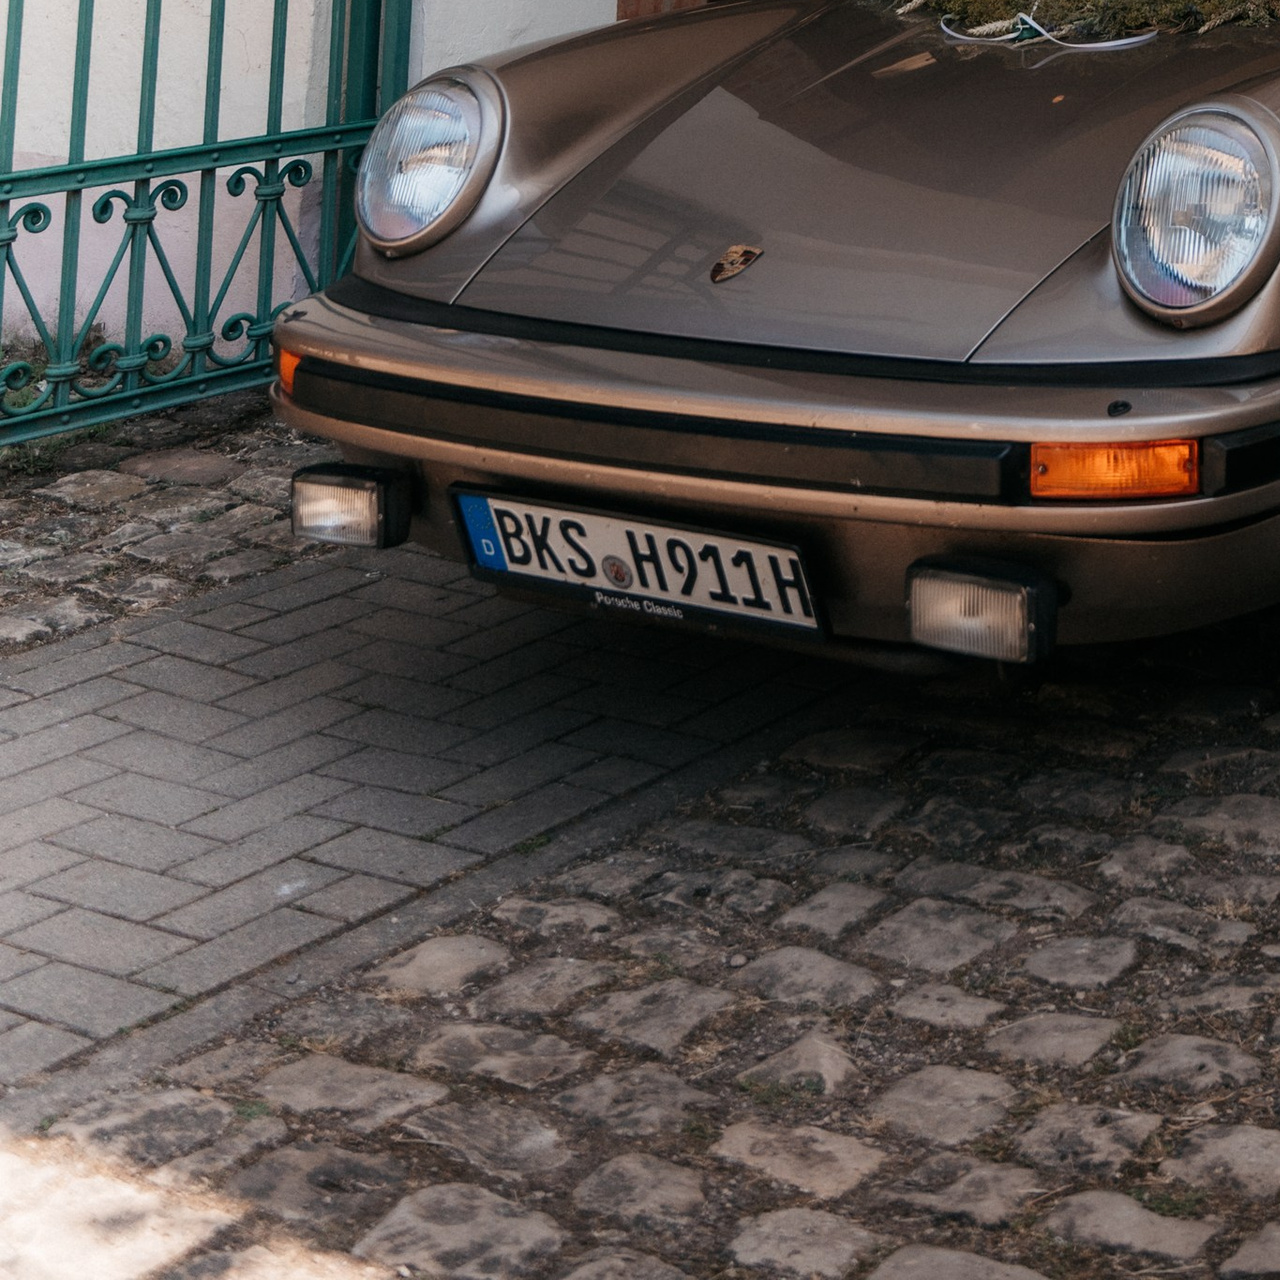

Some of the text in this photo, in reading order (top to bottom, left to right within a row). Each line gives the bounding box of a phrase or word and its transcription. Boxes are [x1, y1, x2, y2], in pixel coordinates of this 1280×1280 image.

[480, 539, 495, 557] D
[493, 507, 815, 619] BKS H911H
[595, 590, 684, 620] Porsche Classic
